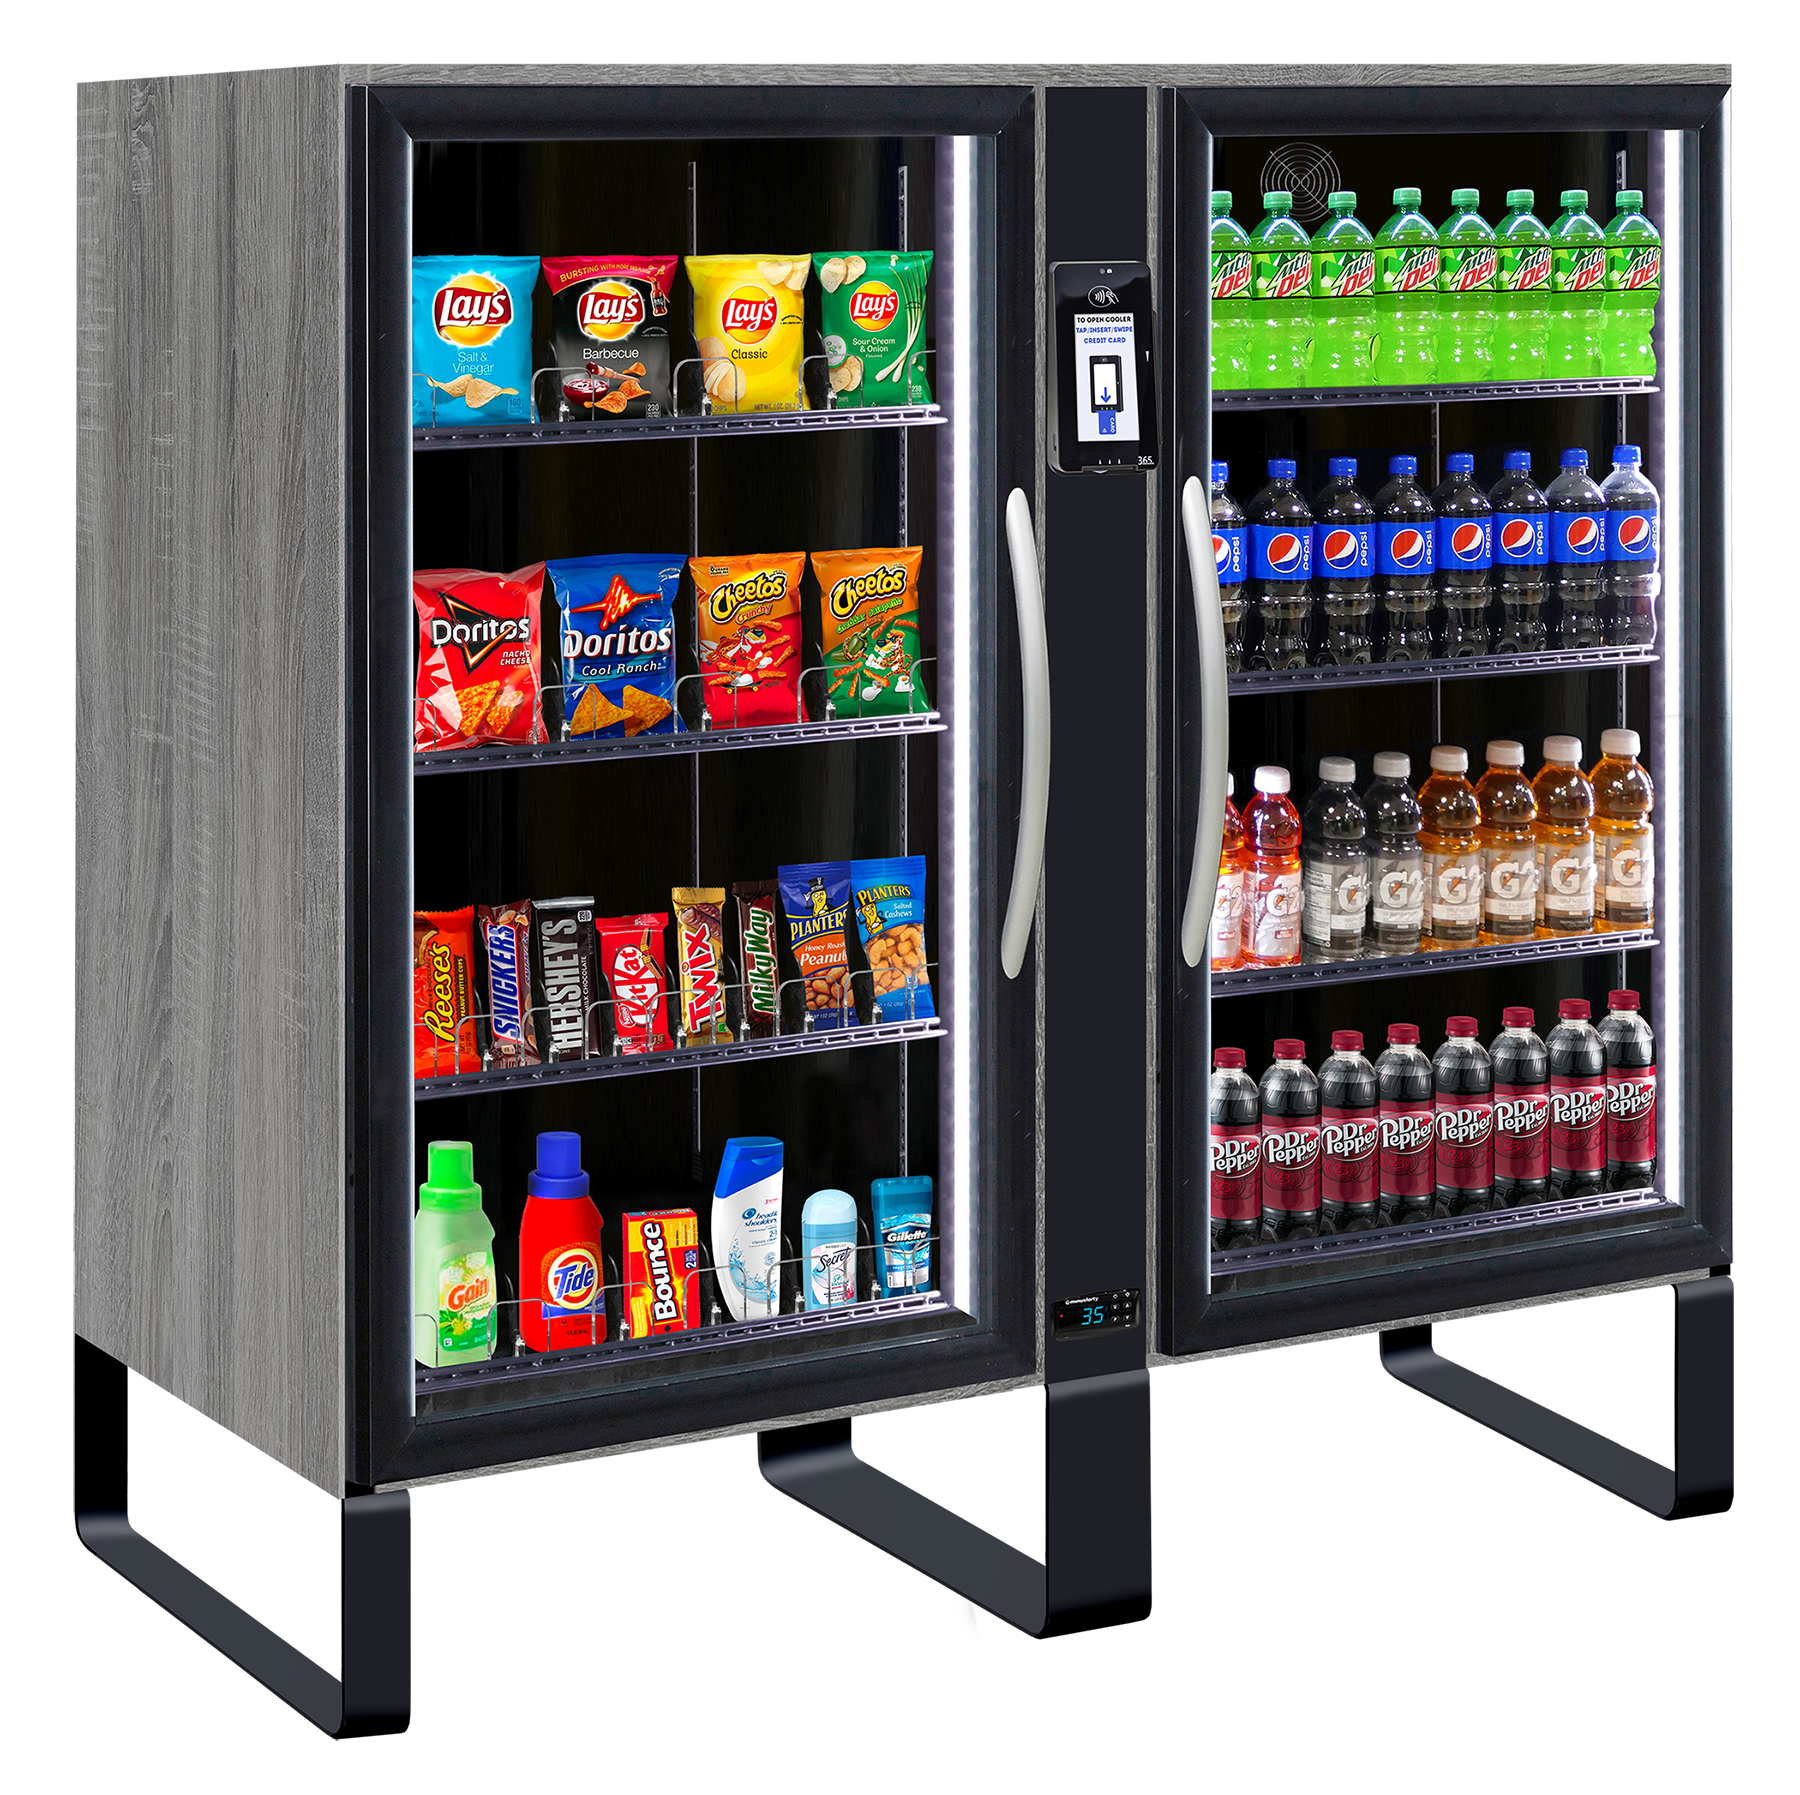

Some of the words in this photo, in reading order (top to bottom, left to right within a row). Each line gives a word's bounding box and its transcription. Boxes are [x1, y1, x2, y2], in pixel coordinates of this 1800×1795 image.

[559, 265, 600, 283] BURSTING
[600, 263, 616, 272] WITH
[439, 289, 507, 327] Lay's
[583, 294, 640, 325] Lay's
[724, 298, 775, 332] Lay's
[852, 293, 897, 327] Lay's
[1077, 316, 1086, 324] TO
[1105, 315, 1132, 323] COOLER
[852, 338, 869, 346] Sour
[871, 337, 896, 346] Cream
[867, 345, 889, 353] Onion
[1107, 336, 1127, 344] CARD
[457, 352, 479, 363] Salt
[480, 351, 487, 362] &
[583, 348, 640, 360] Barbecue
[731, 348, 768, 360] Classic
[452, 362, 495, 375] Vinegar
[647, 403, 660, 412] 230
[1138, 455, 1153, 466] 365
[1536, 521, 1544, 556] pepsi
[1232, 536, 1241, 573] pepsi
[1359, 531, 1368, 567] pepsi
[711, 572, 785, 621] Cheetos
[833, 567, 905, 617] Cheetos
[736, 603, 773, 624] Crunchy
[835, 612, 867, 634] Cheddar
[868, 597, 904, 617] Jalapeño
[432, 618, 530, 646] Doritos
[563, 624, 672, 658] Doritos
[500, 657, 531, 666] CHEESE
[502, 650, 531, 658] NACHO
[582, 663, 611, 677] Cool
[617, 661, 658, 675] Ranch
[1380, 869, 1423, 909] G2
[1490, 860, 1535, 900] G2
[857, 885, 912, 906] PLANTERS
[1266, 883, 1301, 917] G2
[884, 910, 913, 919] Cashews
[893, 902, 913, 910] Salted
[804, 943, 825, 952] Honey
[489, 924, 520, 1039] SNICKERS
[541, 918, 583, 1050] HERSHEY'S
[581, 956, 589, 994] CHOCOLATE
[684, 924, 722, 1032] TWIX
[423, 941, 456, 1043] Reese's
[458, 976, 466, 995] BUTTER
[1570, 1090, 1596, 1110] Dr
[1619, 1082, 1644, 1101] Dr
[1457, 1108, 1482, 1127] Dr
[1494, 1101, 1549, 1134] Pepper
[1514, 1099, 1540, 1118] Dr
[1551, 1093, 1605, 1126] Pepper
[1342, 1122, 1368, 1141] Dr
[1380, 1118, 1433, 1150] Pepper
[1400, 1115, 1424, 1134] Dr
[1436, 1110, 1492, 1143] Pepper
[1611, 1123, 1626, 1134] 23
[1284, 1131, 1310, 1149] Dr
[1321, 1125, 1378, 1157] Pepper
[1506, 1140, 1521, 1151] 23
[1562, 1132, 1577, 1143] 23
[1224, 1139, 1250, 1158] Dr
[1263, 1134, 1319, 1166] Pepper
[1449, 1150, 1464, 1161] 23
[1335, 1163, 1350, 1175] 23
[1391, 1156, 1406, 1168] 23
[1217, 1180, 1232, 1193] 23
[1276, 1172, 1291, 1185] 23
[887, 1229, 928, 1243] Gillette
[816, 1246, 852, 1273] Secret
[553, 1261, 595, 1301] Tide
[642, 1221, 679, 1322] Bounce
[447, 1277, 488, 1311] Gain
[1080, 1305, 1105, 1326] 35
